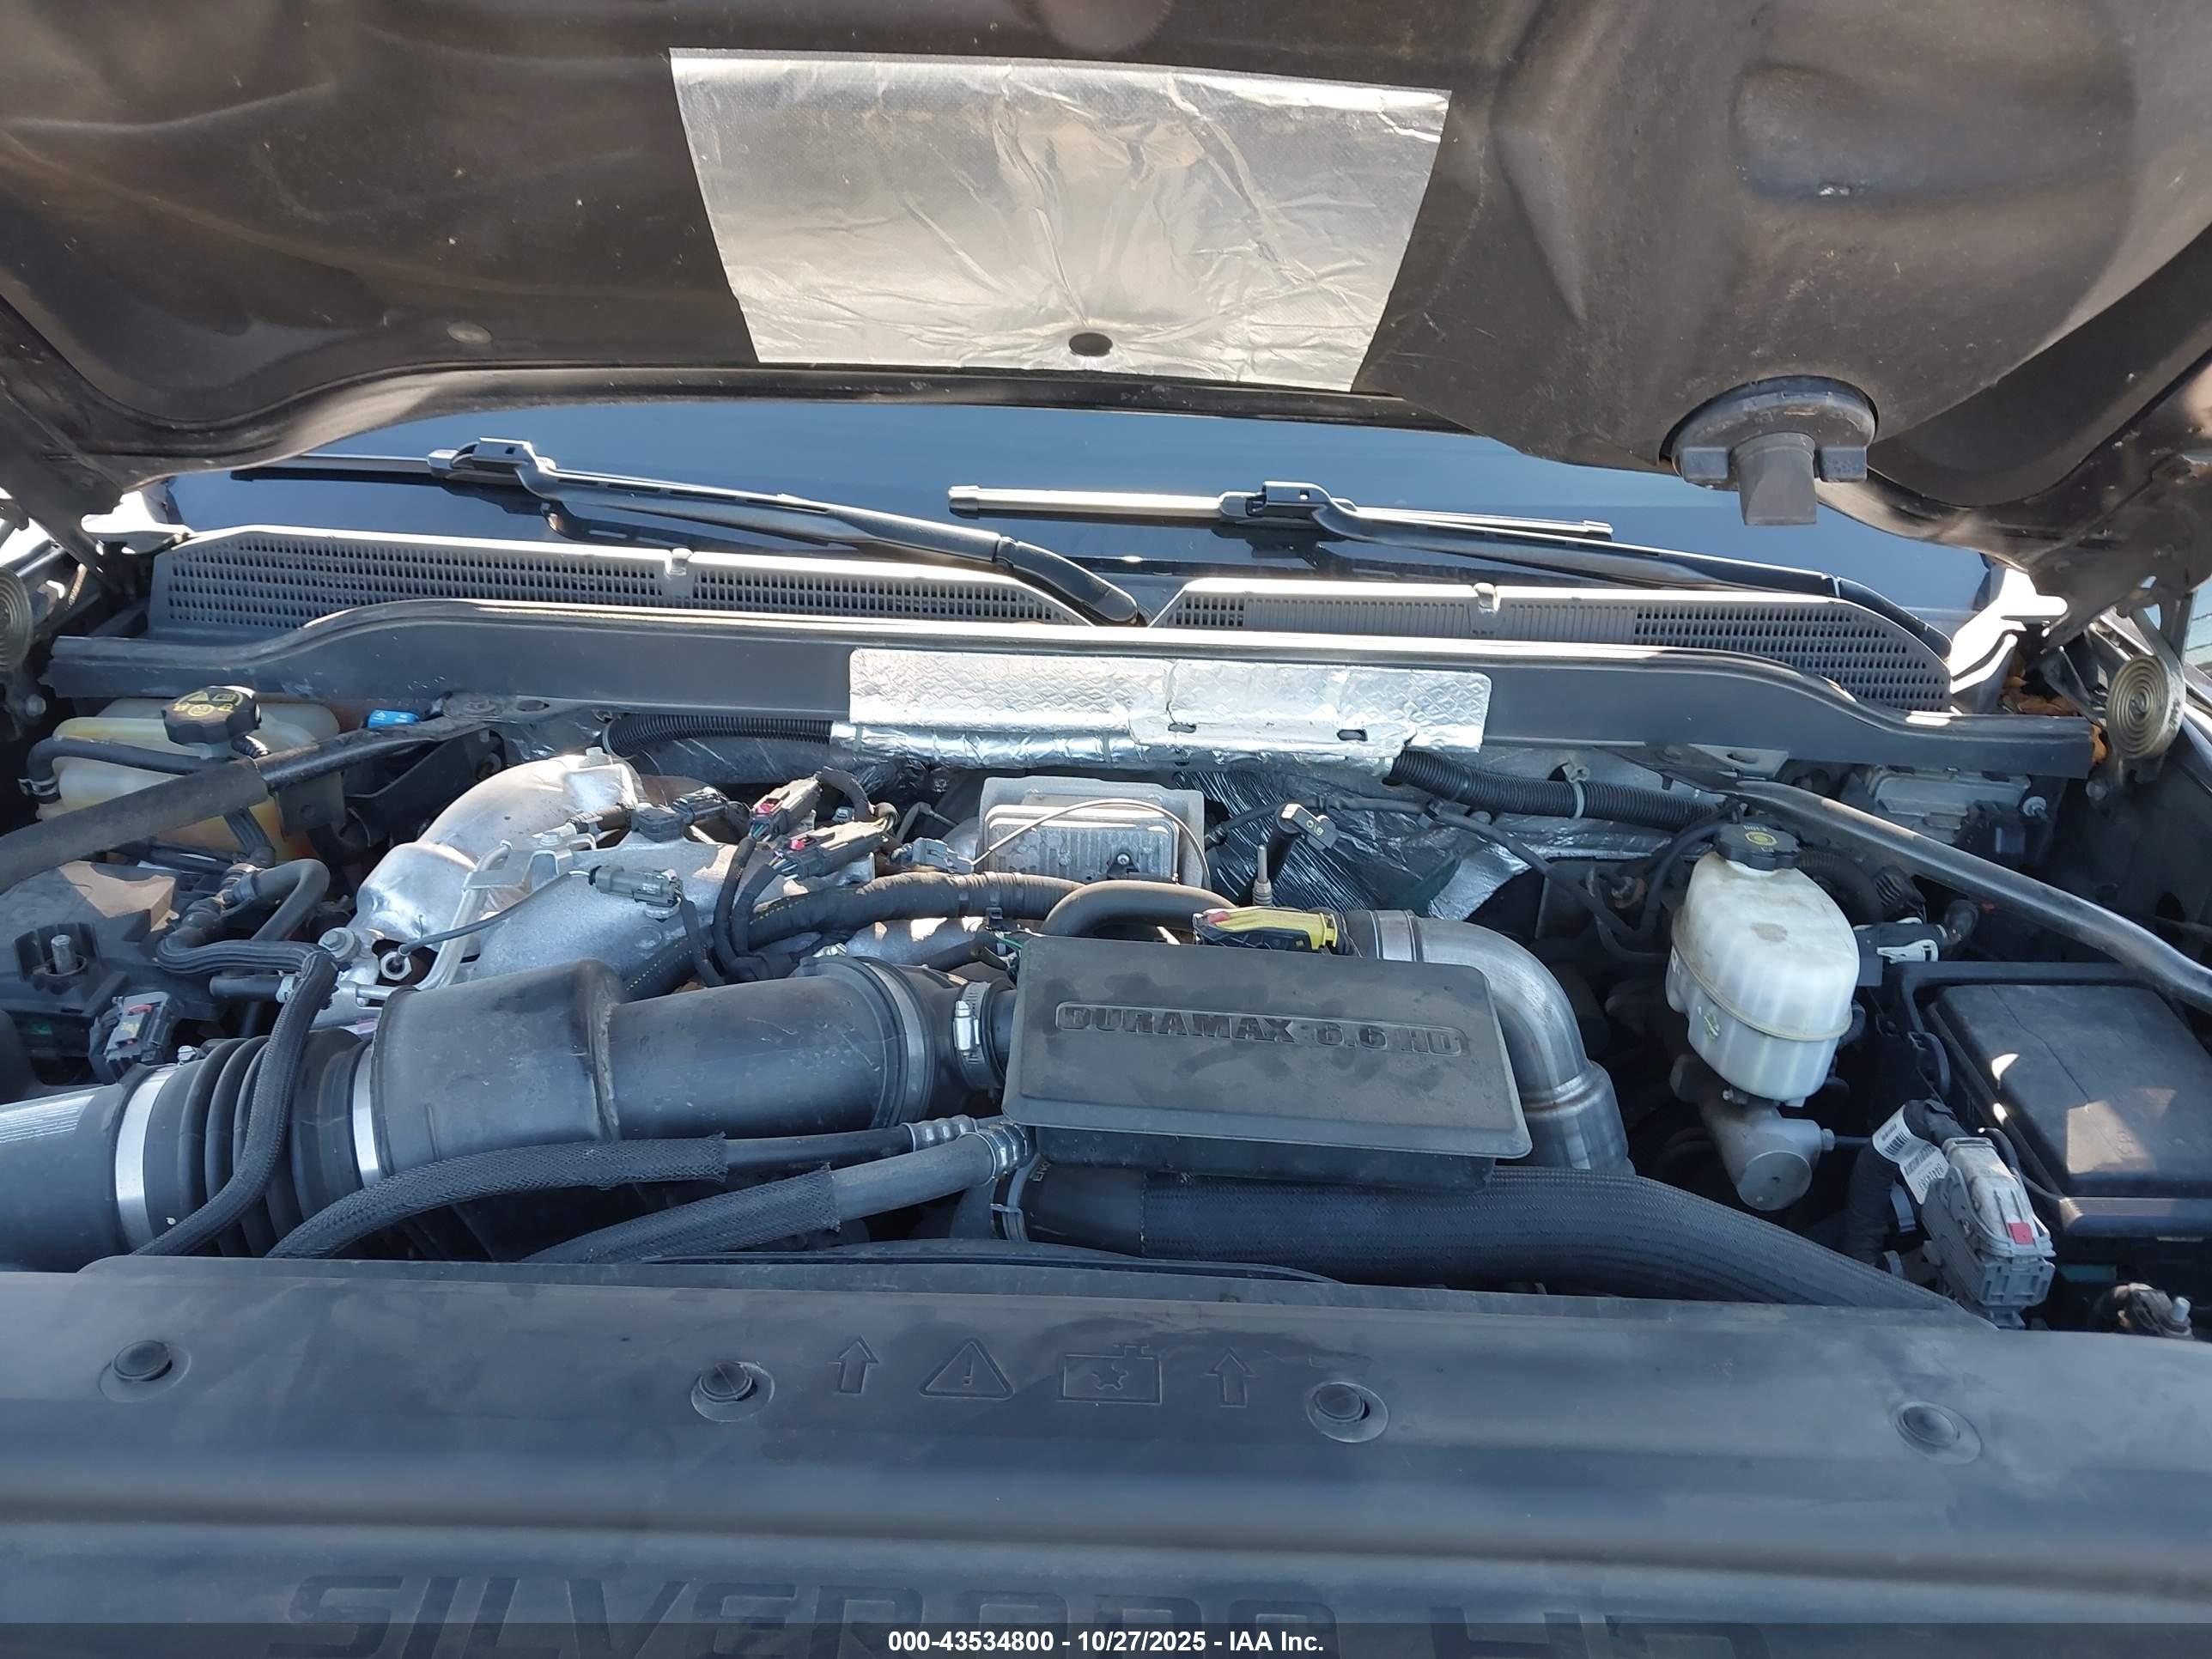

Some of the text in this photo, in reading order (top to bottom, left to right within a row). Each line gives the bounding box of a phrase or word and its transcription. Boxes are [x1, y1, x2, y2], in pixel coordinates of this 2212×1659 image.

[1063, 1006, 1462, 1056] DURAMAX 6.6 HD
